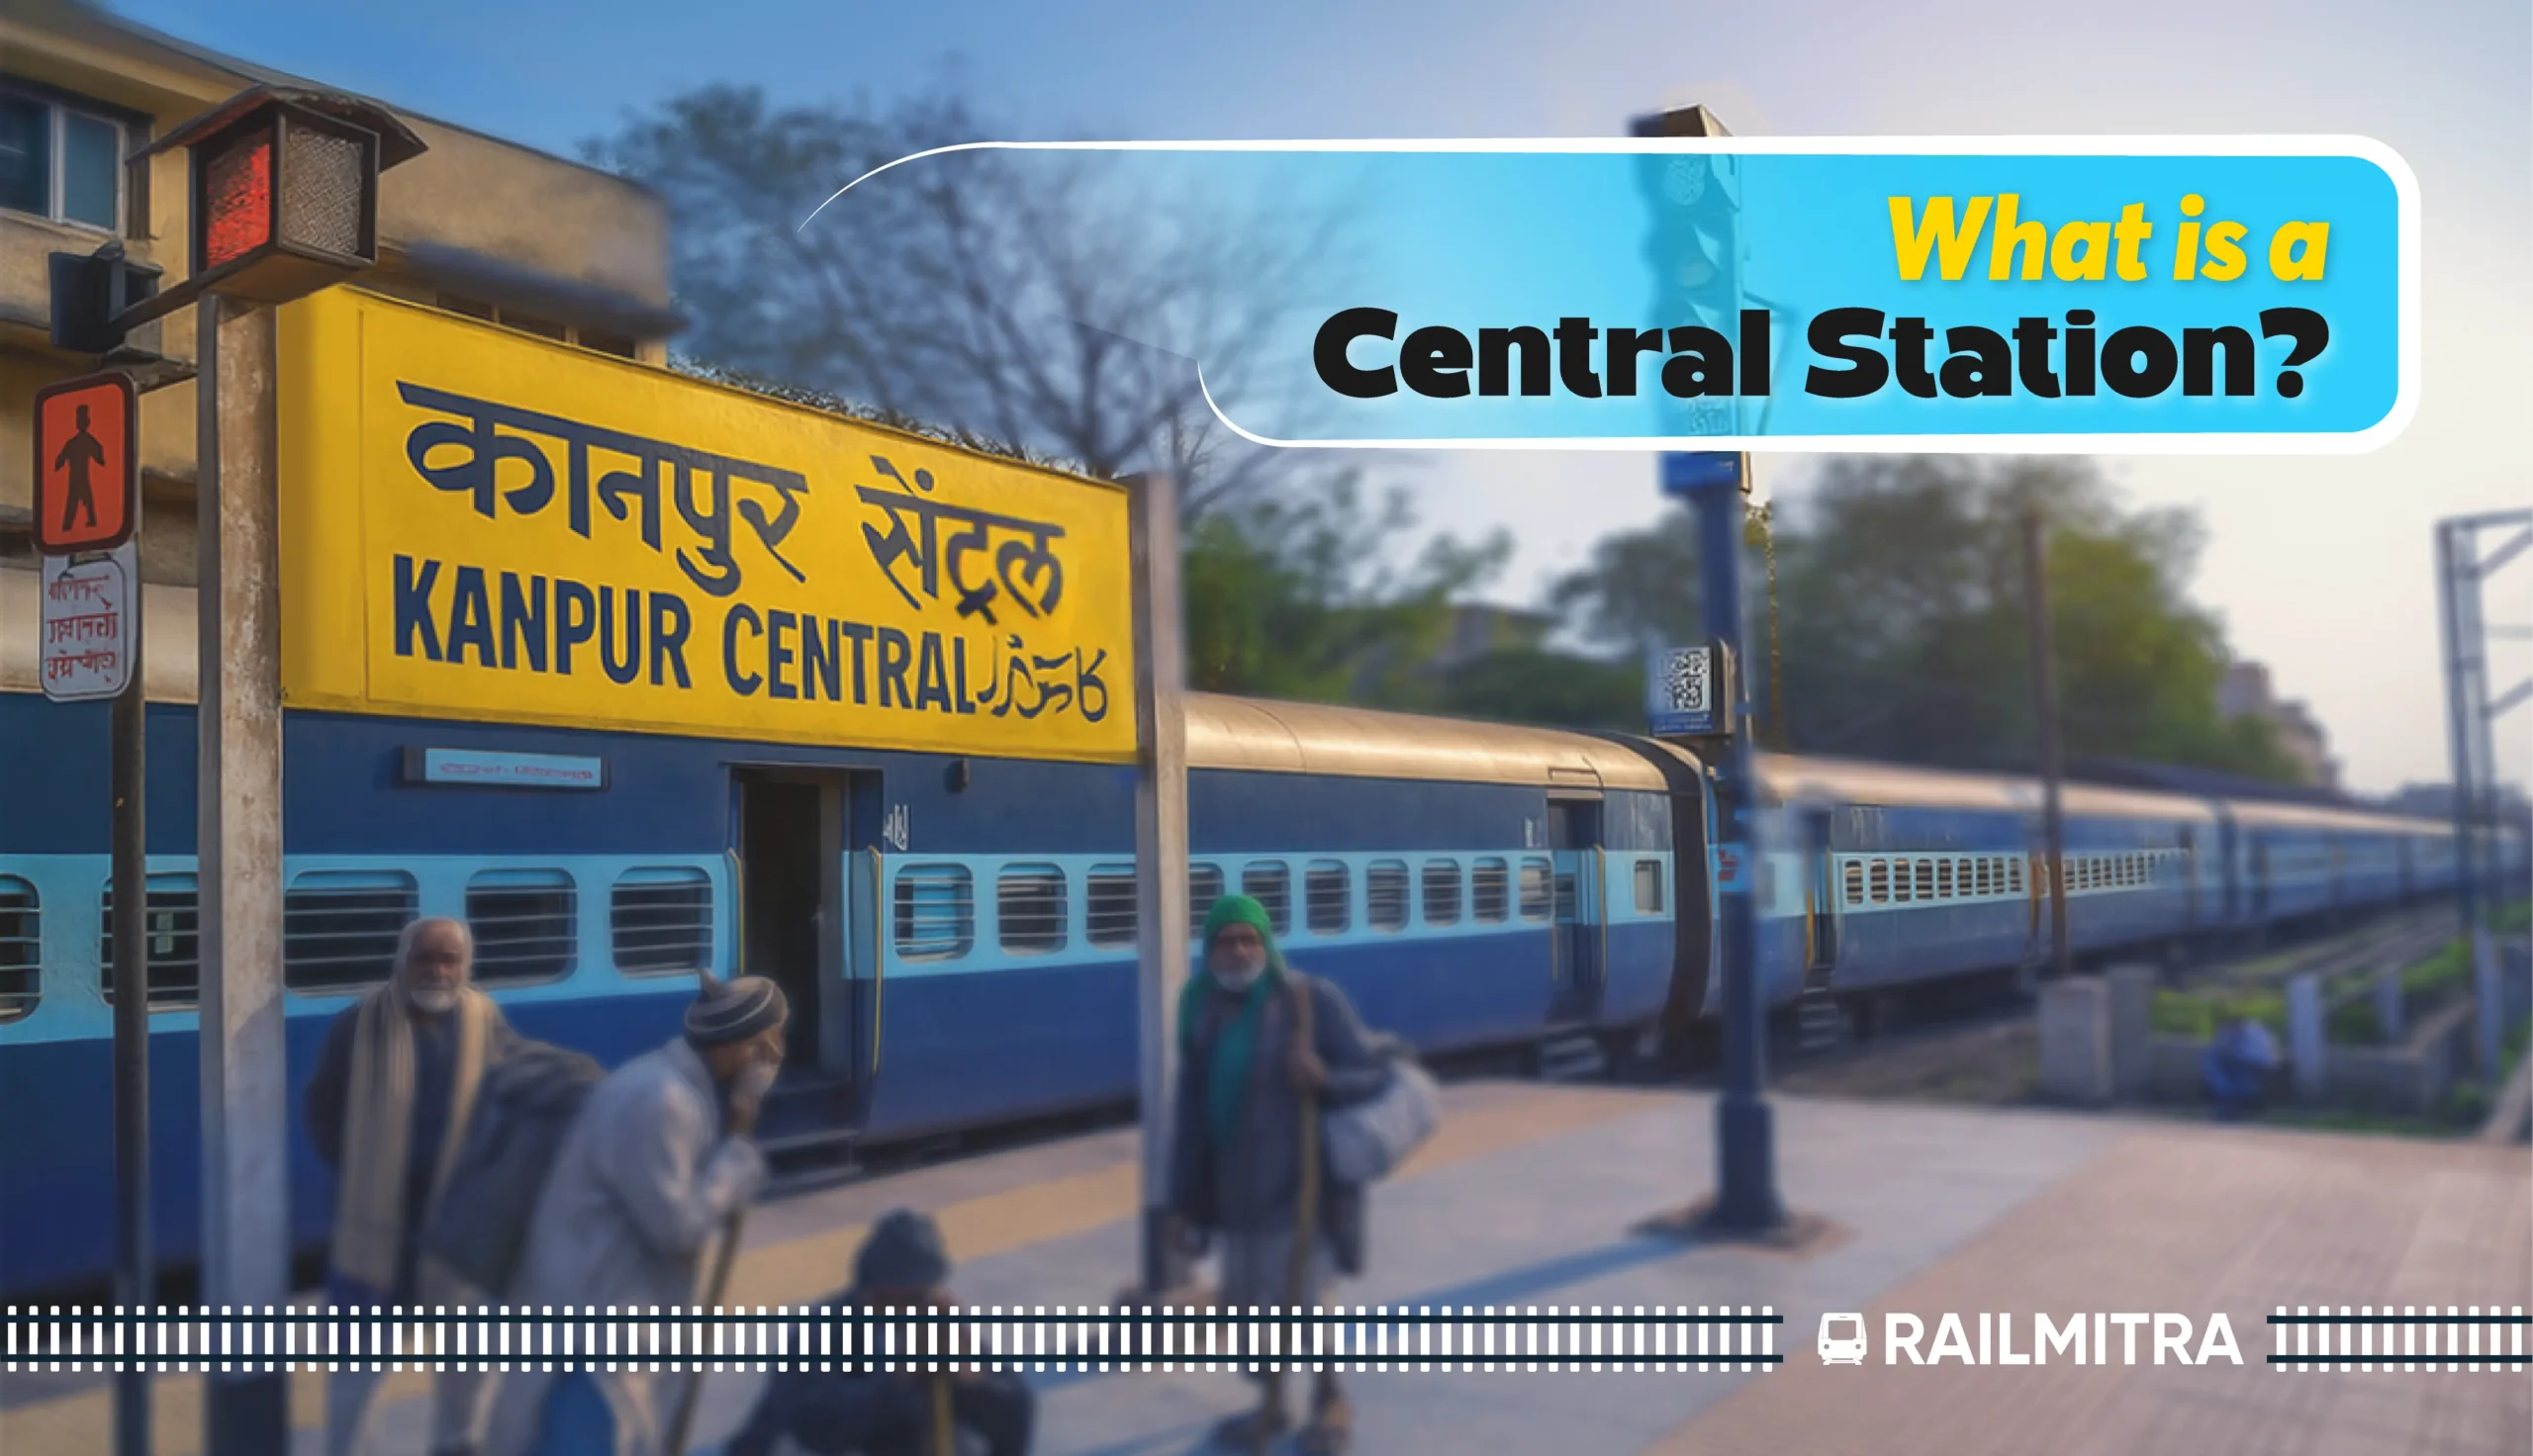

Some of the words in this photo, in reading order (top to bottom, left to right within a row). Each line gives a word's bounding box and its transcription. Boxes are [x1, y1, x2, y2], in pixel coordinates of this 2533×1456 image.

[395, 380, 809, 597] कानपुर
[855, 455, 1066, 626] सेंट्रल
[393, 552, 693, 690] KANPUR
[722, 601, 978, 715] CENTRAL
